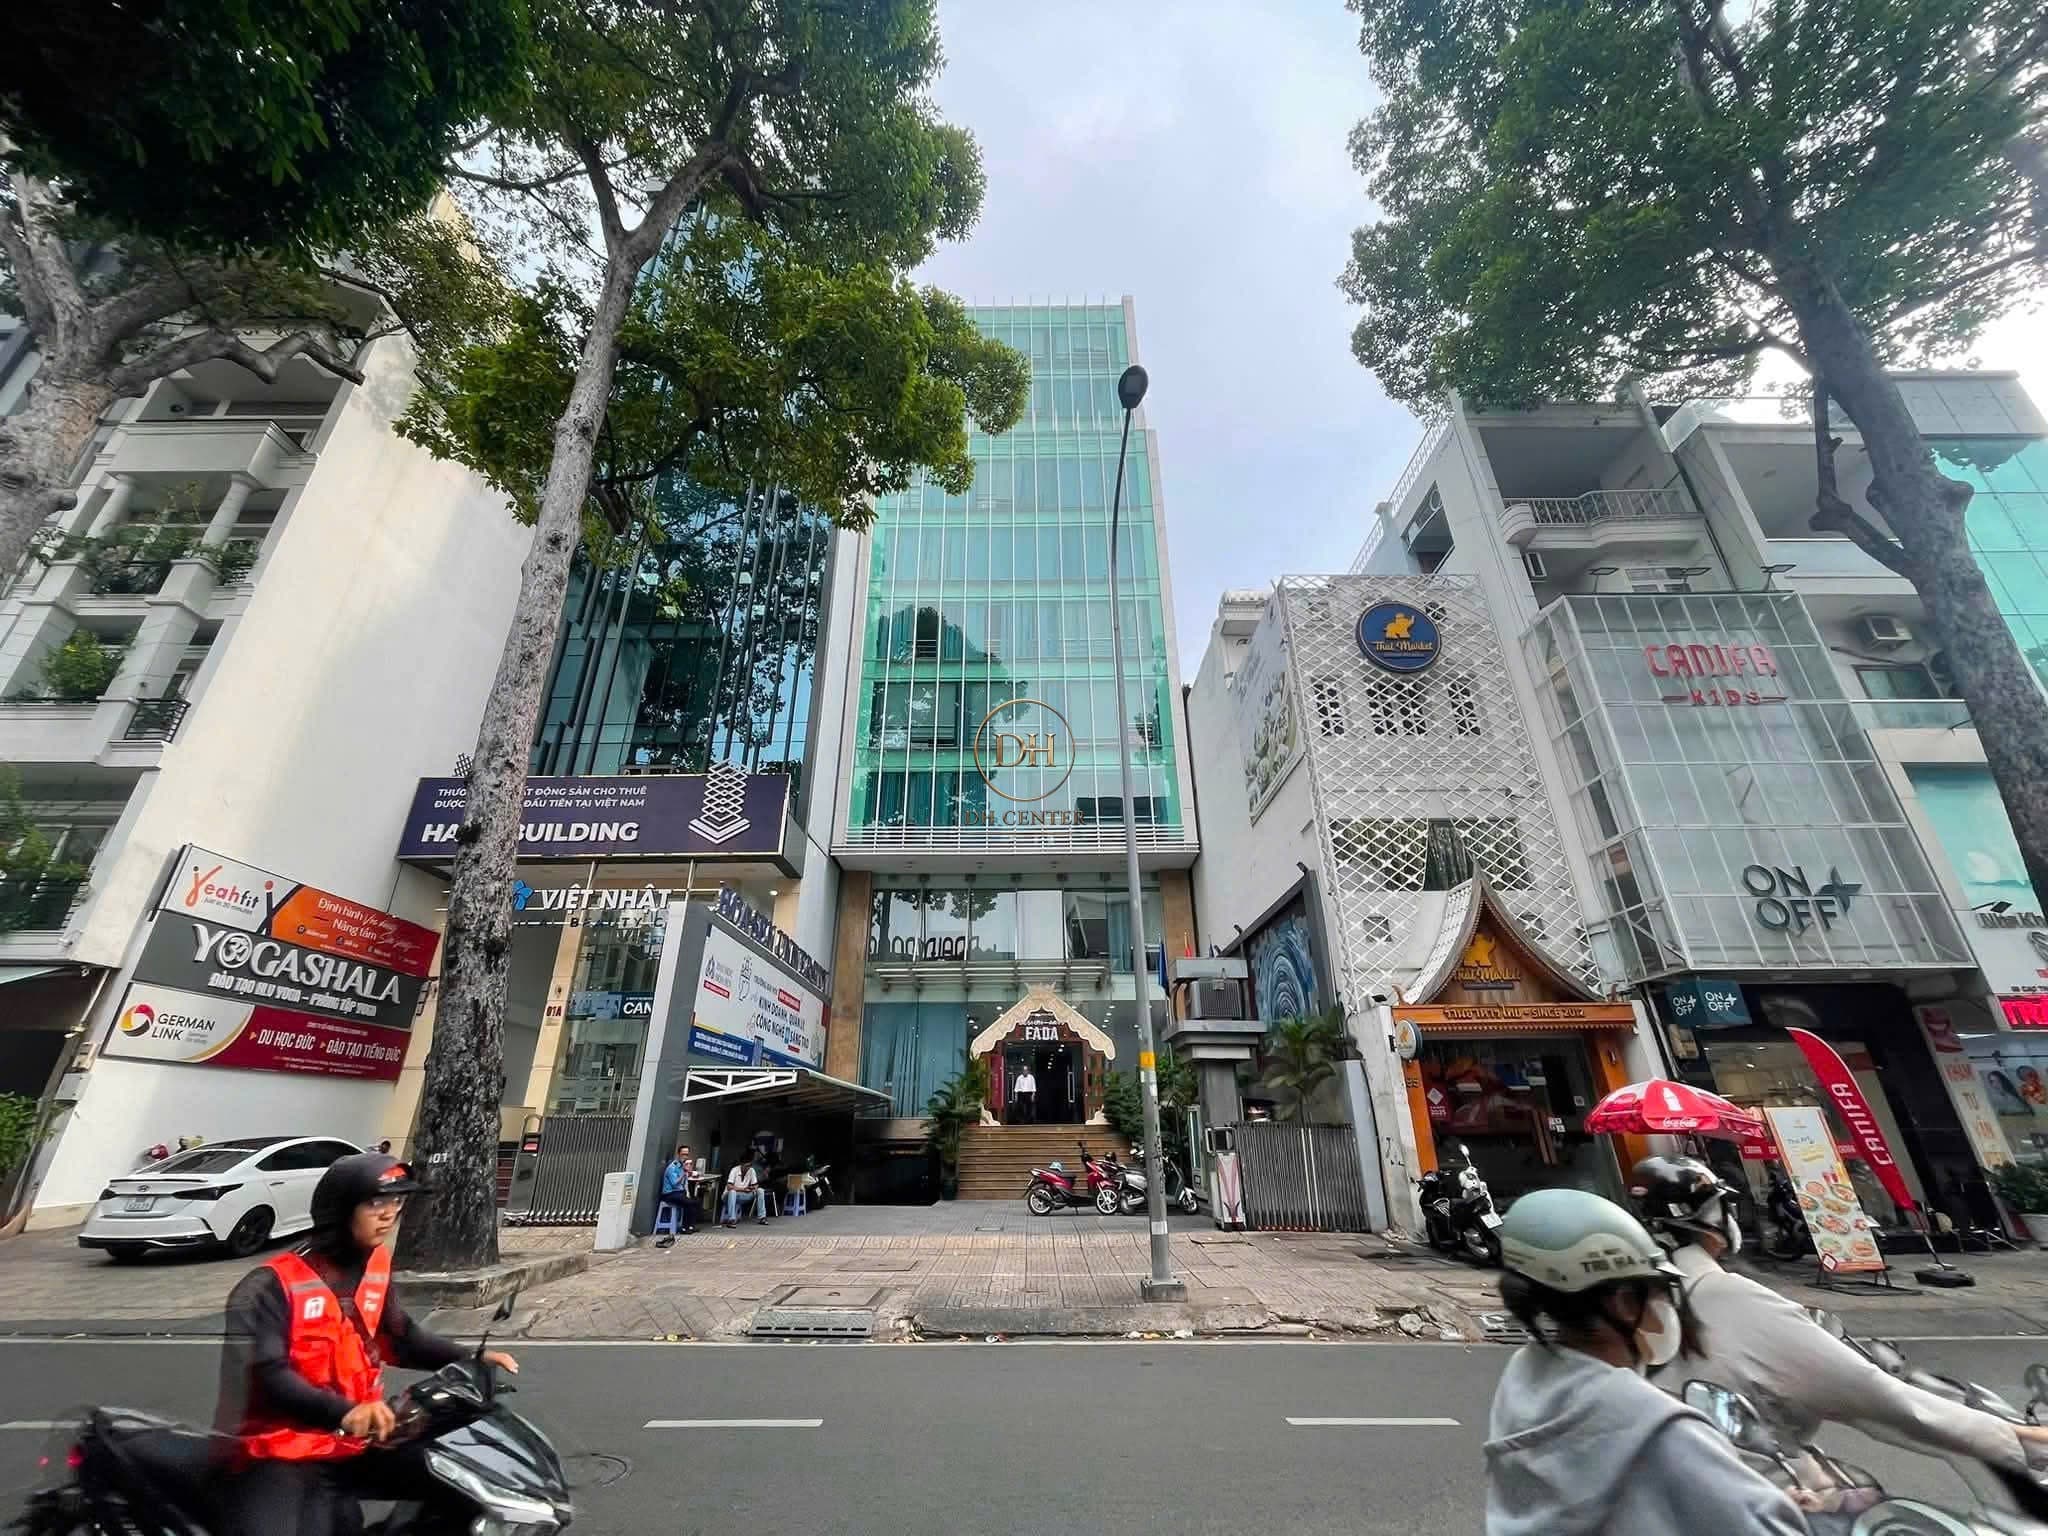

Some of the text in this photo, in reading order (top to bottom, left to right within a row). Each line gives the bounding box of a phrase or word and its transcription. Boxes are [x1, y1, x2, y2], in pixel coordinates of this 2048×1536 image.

[1646, 643, 1777, 677] CANIFA
[1692, 689, 1760, 706] KIDS
[593, 787, 616, 796] CHO
[619, 785, 647, 796] THUÊ
[575, 799, 593, 809] TẠI
[595, 797, 618, 809] VIỆT
[620, 799, 645, 807] NAM
[542, 883, 672, 914] VIỆT NHẬT
[1756, 898, 1838, 931] OFF
[1531, 1007, 1561, 1018] SINCE
[158, 1013, 216, 1031] GERMAN
[152, 1027, 183, 1041] LINK
[258, 1028, 274, 1045] DU
[1831, 1083, 1893, 1165] CANIFA
